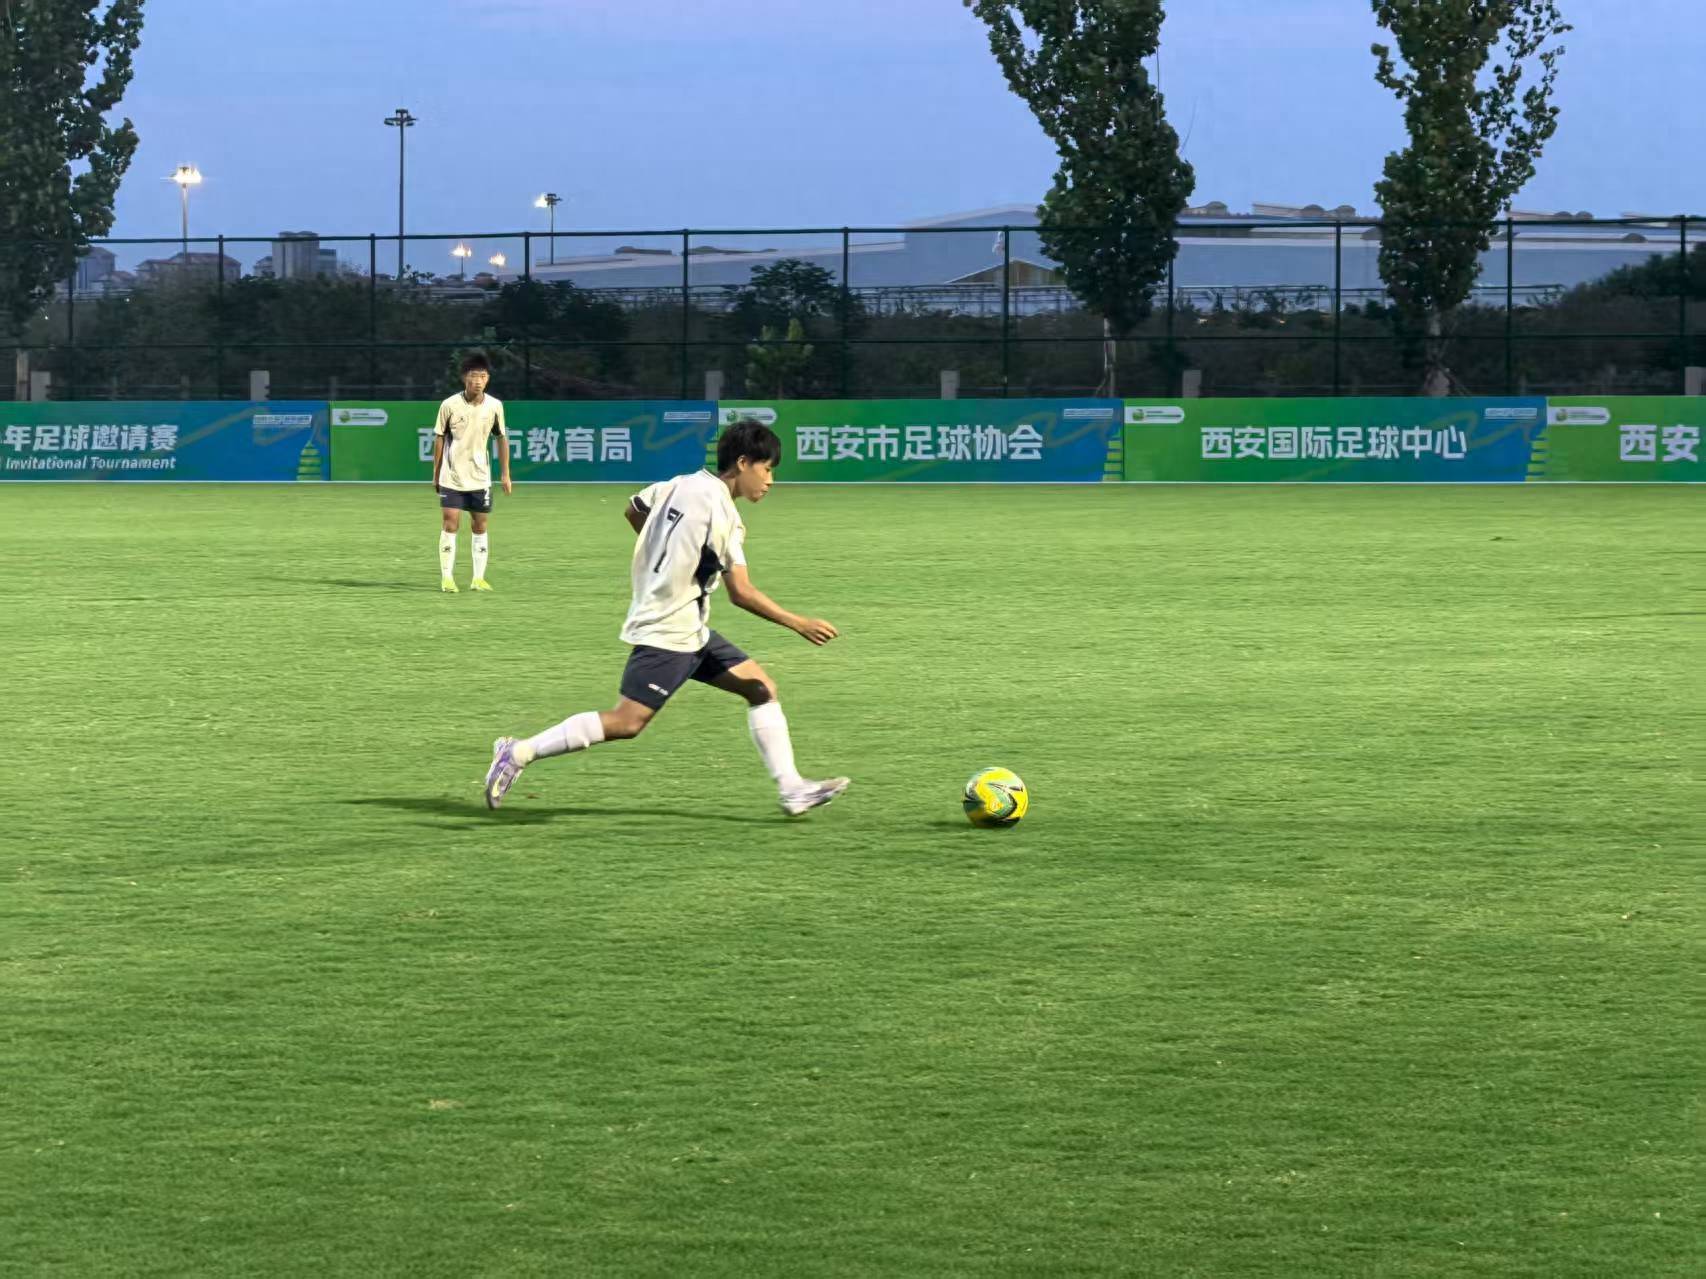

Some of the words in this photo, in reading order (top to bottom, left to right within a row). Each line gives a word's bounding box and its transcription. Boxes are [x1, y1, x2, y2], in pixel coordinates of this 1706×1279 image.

[0, 424, 178, 451] 年足球邀请赛
[417, 427, 632, 462] 西市教育局
[796, 424, 1043, 461] 西安市足球协会
[1200, 425, 1468, 460] 西安国际足球中心
[1619, 424, 1700, 462] 西安
[6, 455, 87, 470] Invitational
[91, 456, 177, 470] Tournament
